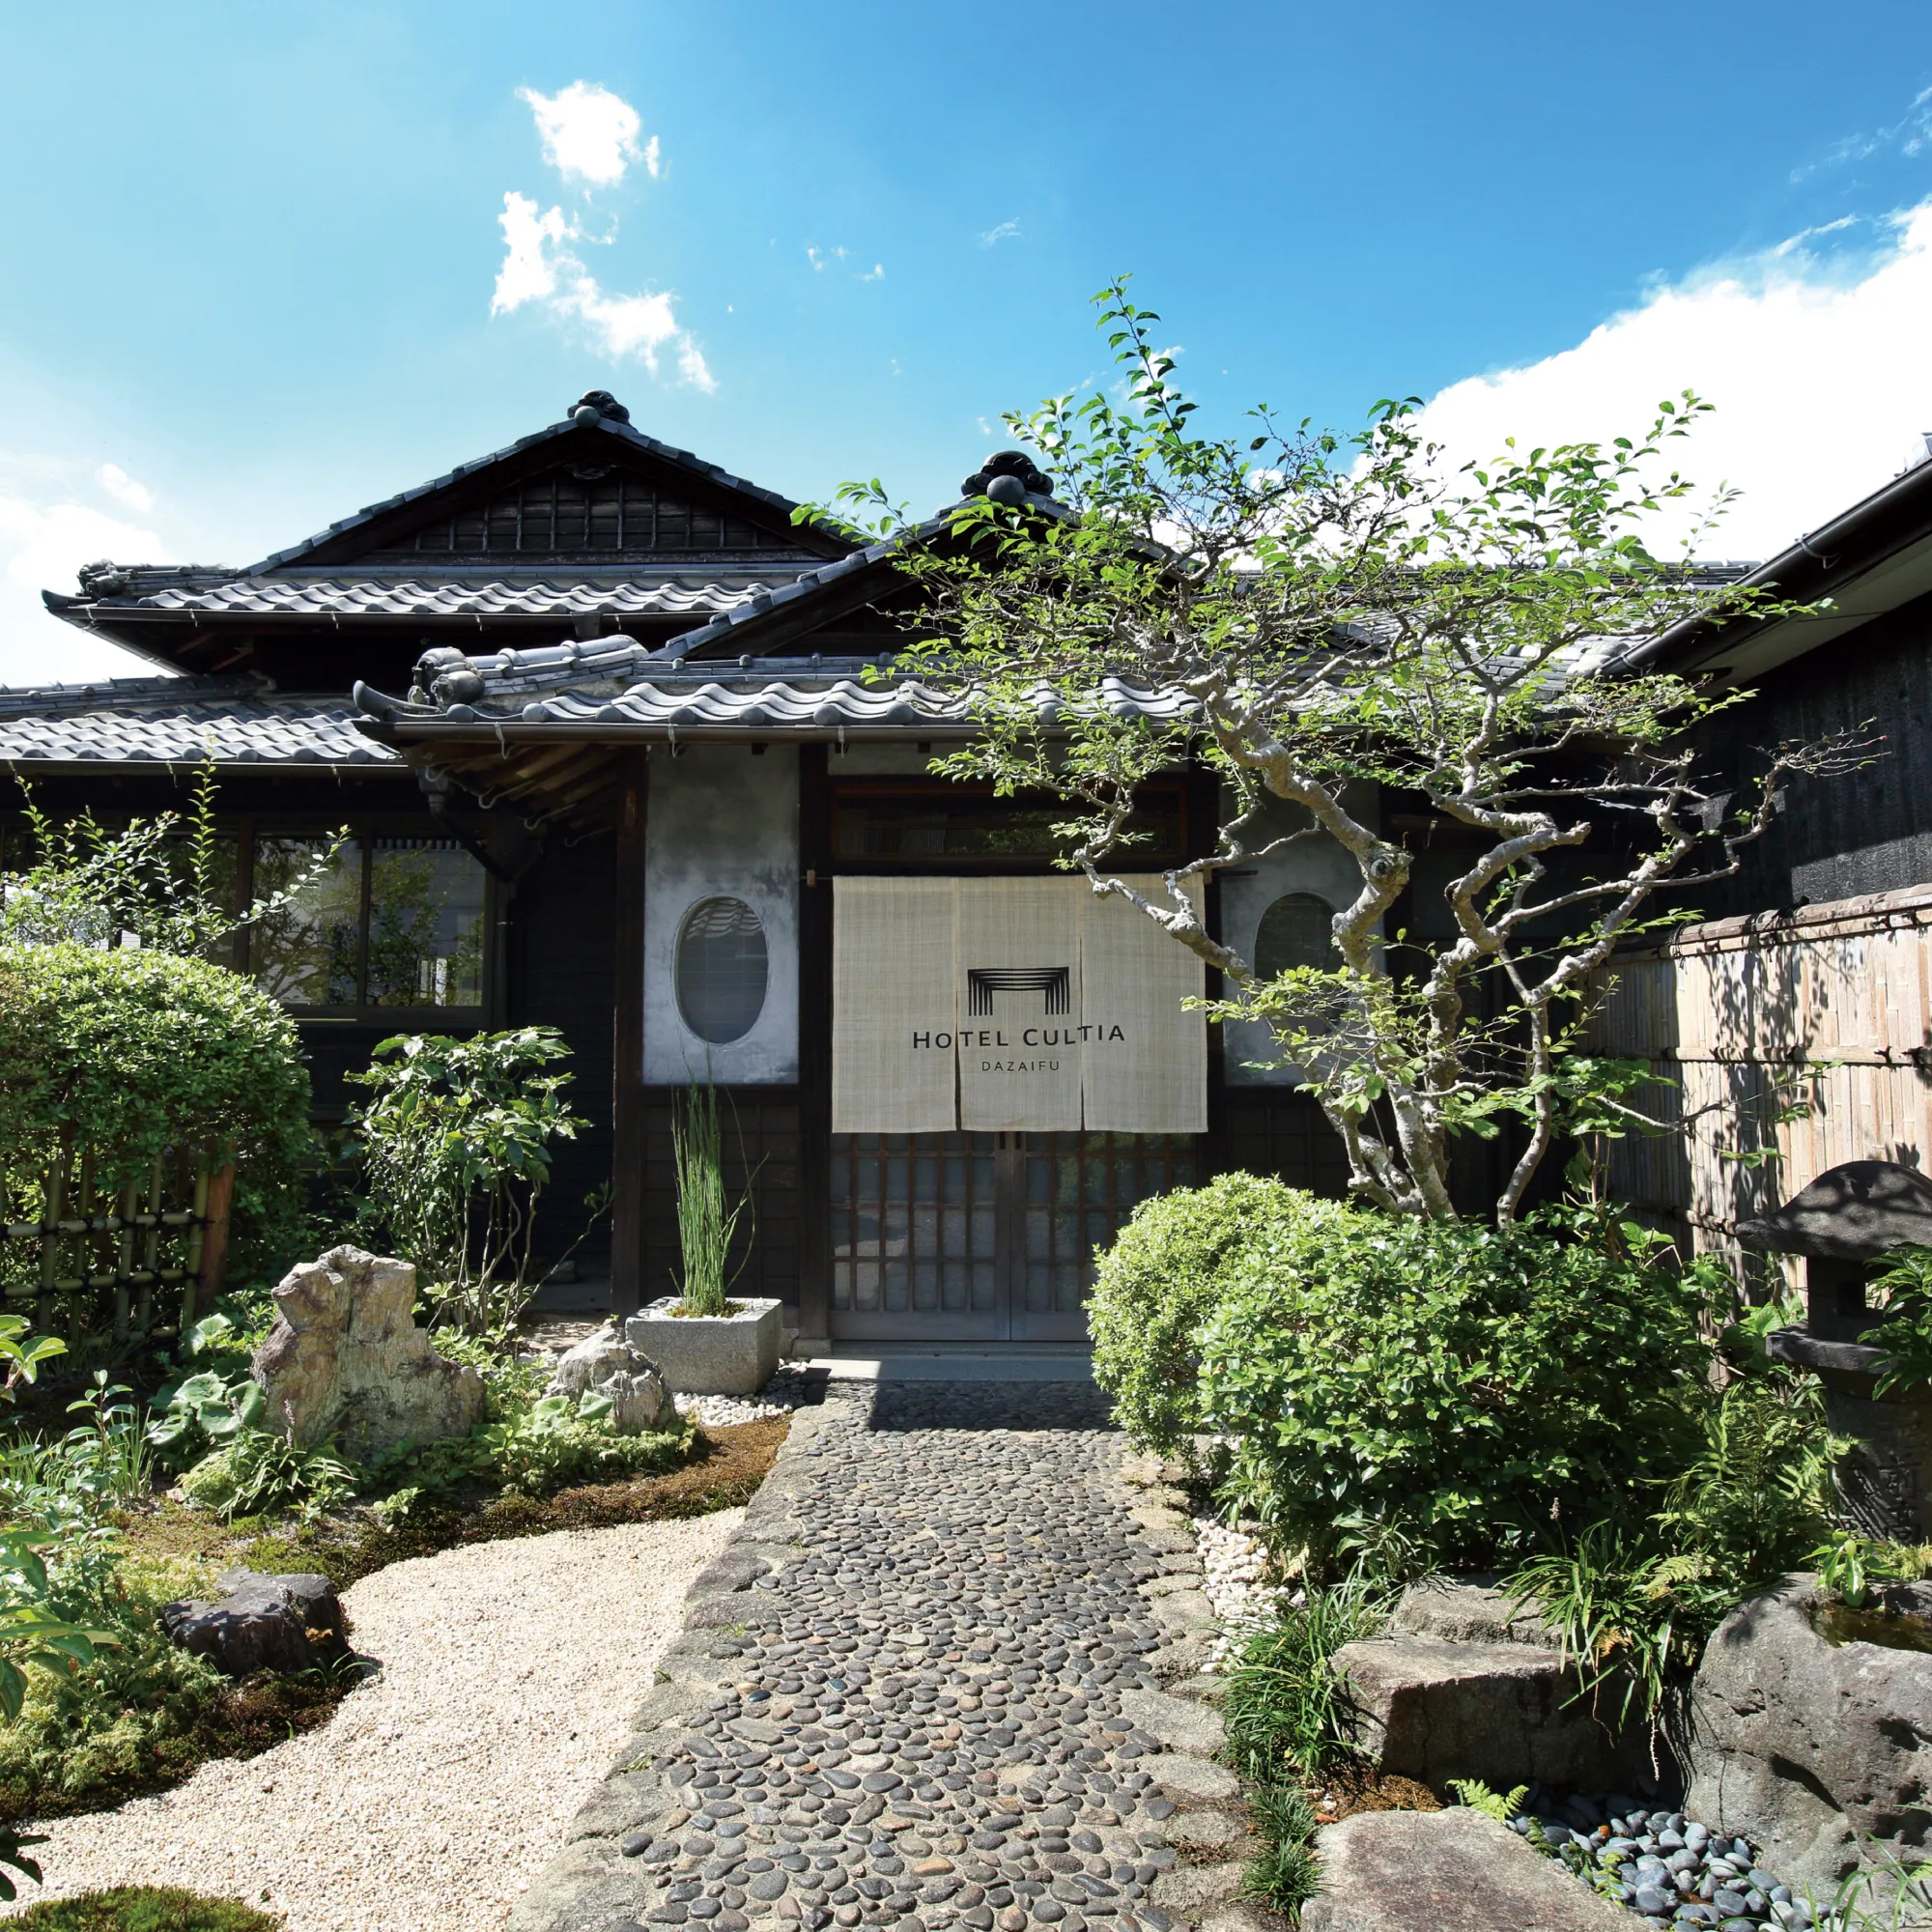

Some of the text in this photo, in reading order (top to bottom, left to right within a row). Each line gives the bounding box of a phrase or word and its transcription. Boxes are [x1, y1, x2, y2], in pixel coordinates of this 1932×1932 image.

[913, 1024, 1125, 1049] HOTEL CULTIA
[981, 1061, 1060, 1071] DAZAIFU
